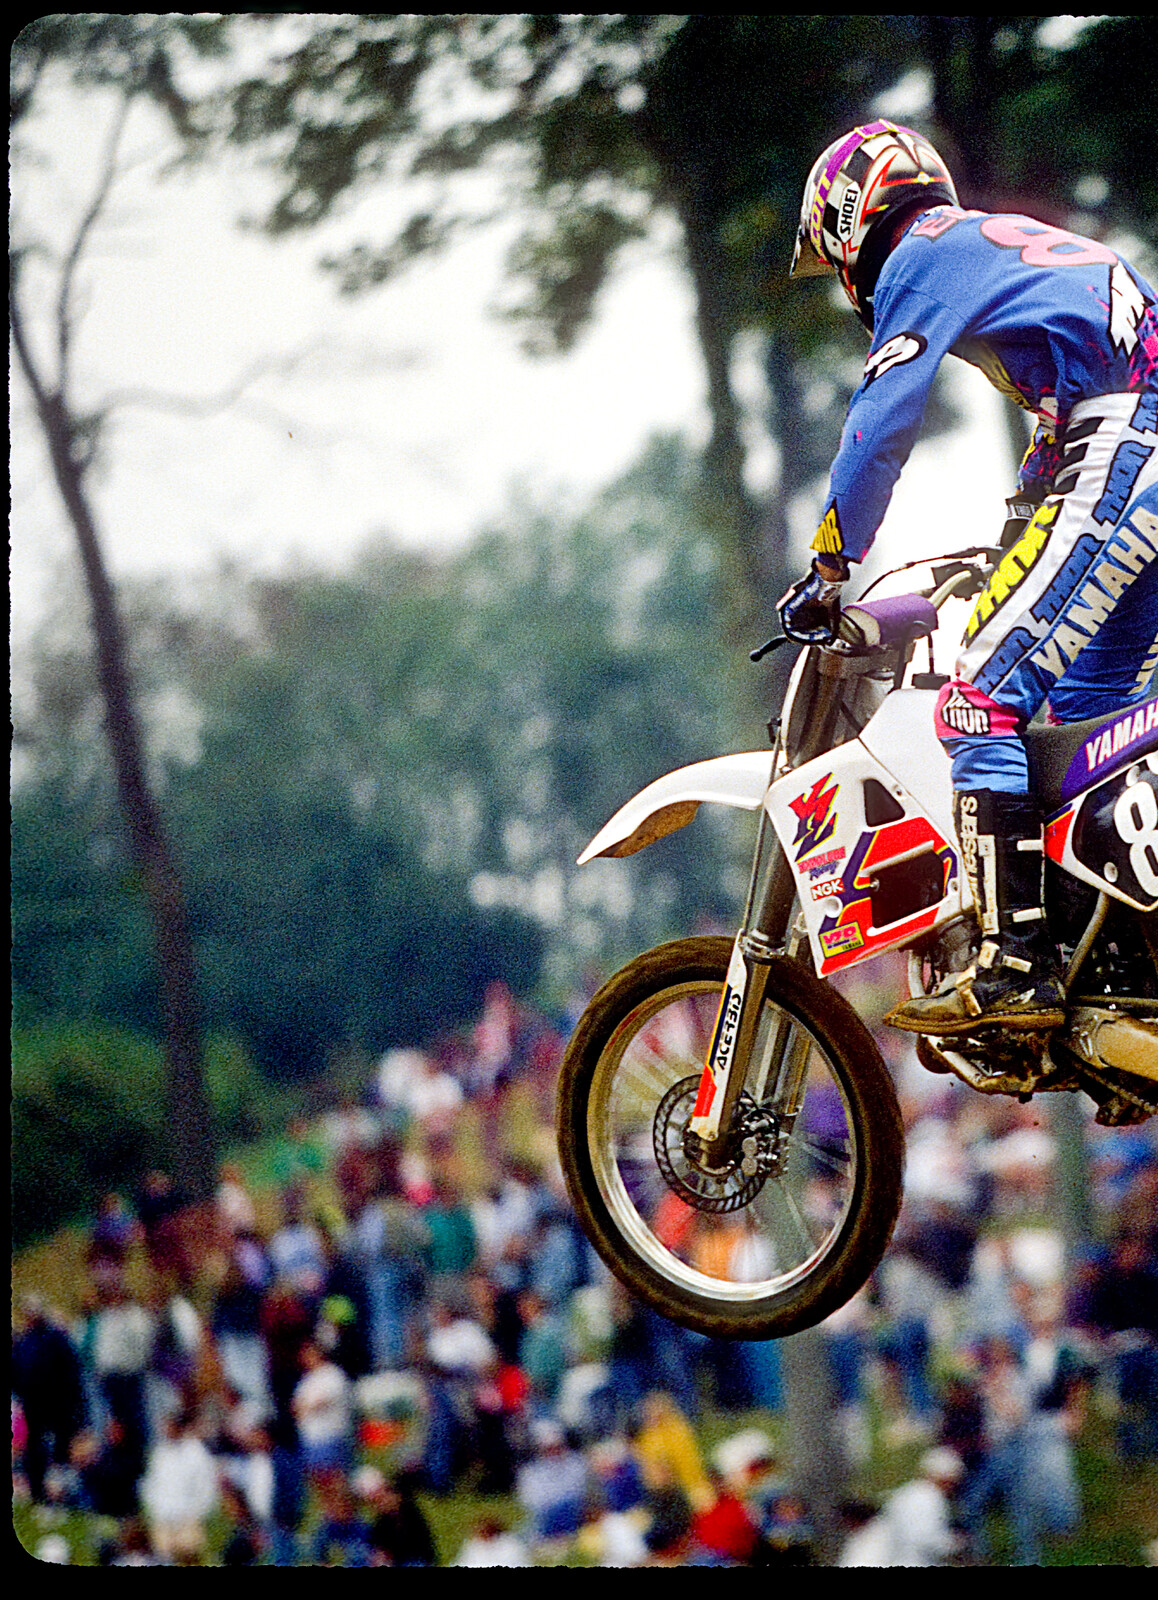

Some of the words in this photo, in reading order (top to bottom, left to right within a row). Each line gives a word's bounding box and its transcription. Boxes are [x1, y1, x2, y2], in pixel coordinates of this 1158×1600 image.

[840, 188, 859, 236] SHOEI
[980, 215, 1119, 267] 8
[812, 879, 843, 901] NGK
[716, 993, 742, 1071] ACERBIS
